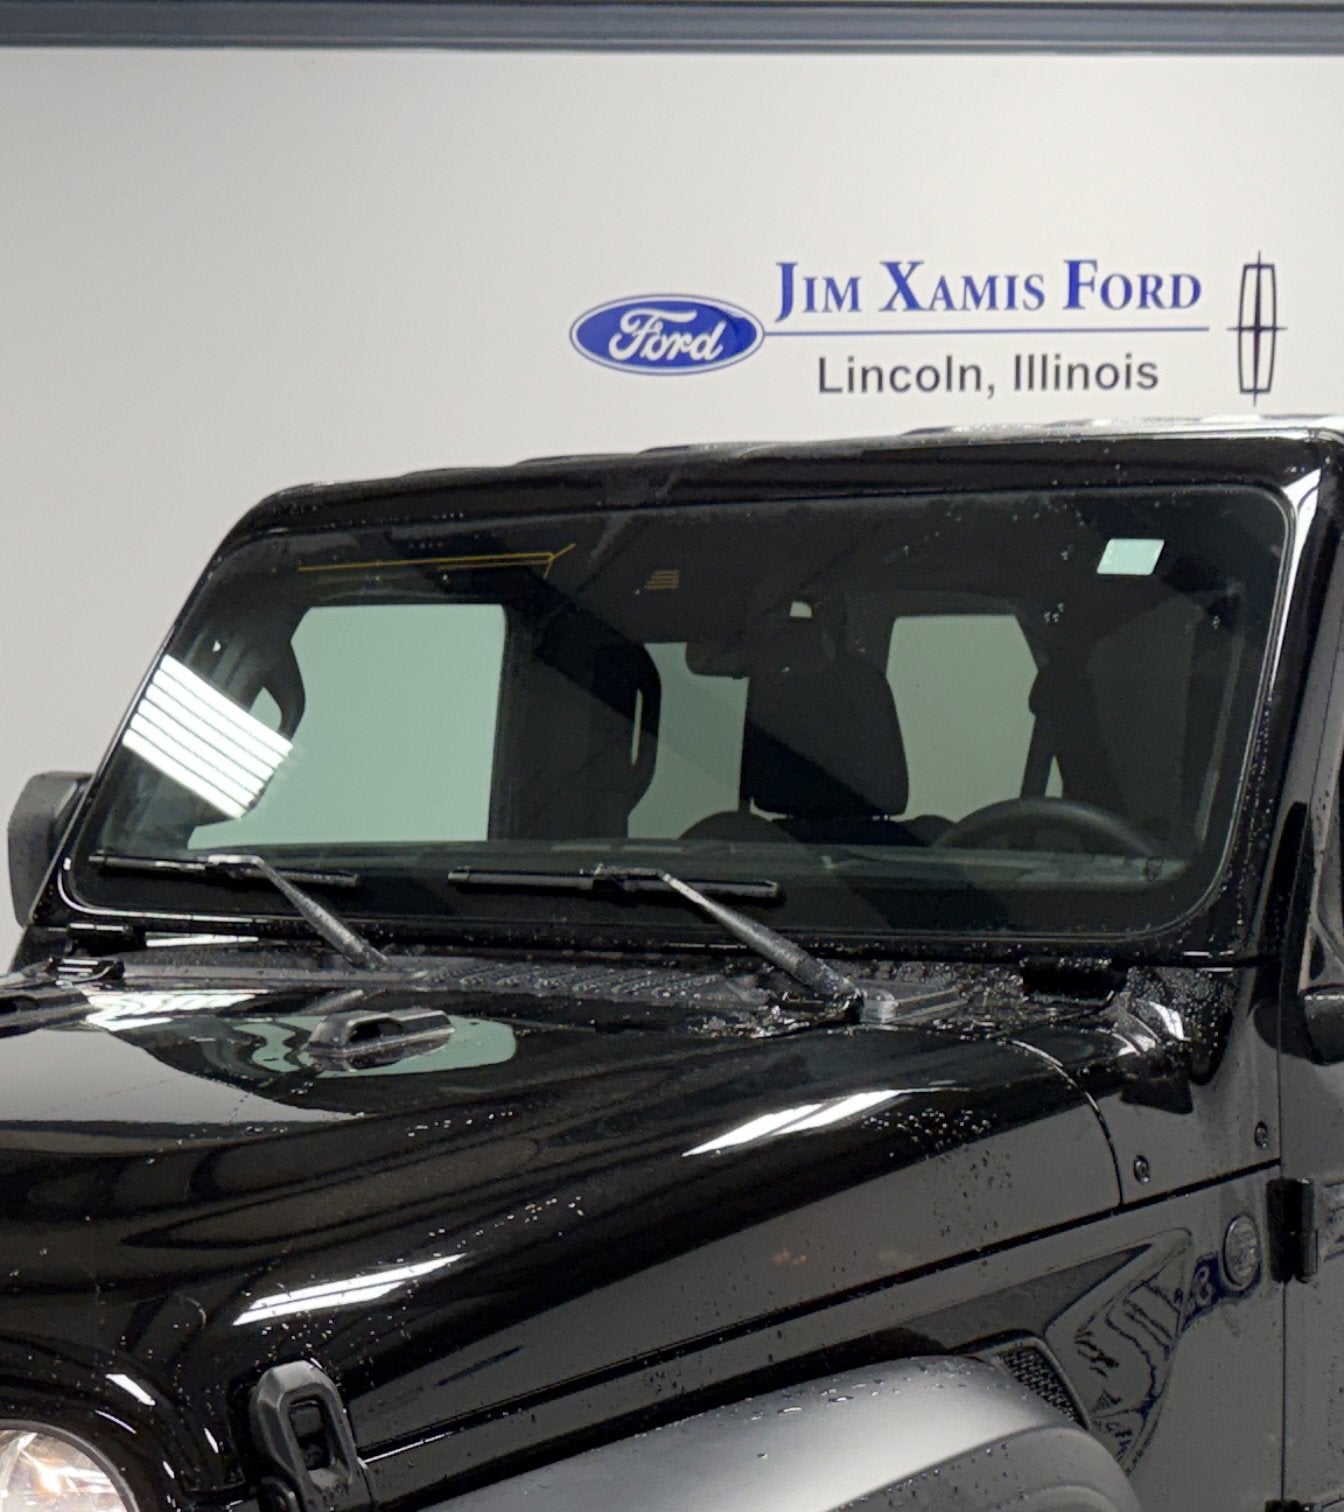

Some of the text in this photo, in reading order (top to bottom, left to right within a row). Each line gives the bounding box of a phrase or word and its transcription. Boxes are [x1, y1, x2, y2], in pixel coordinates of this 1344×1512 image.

[775, 259, 1202, 323] JIM XAMIS FORD
[606, 310, 724, 362] Ford
[818, 353, 1160, 399] Lincoln, Illinois
